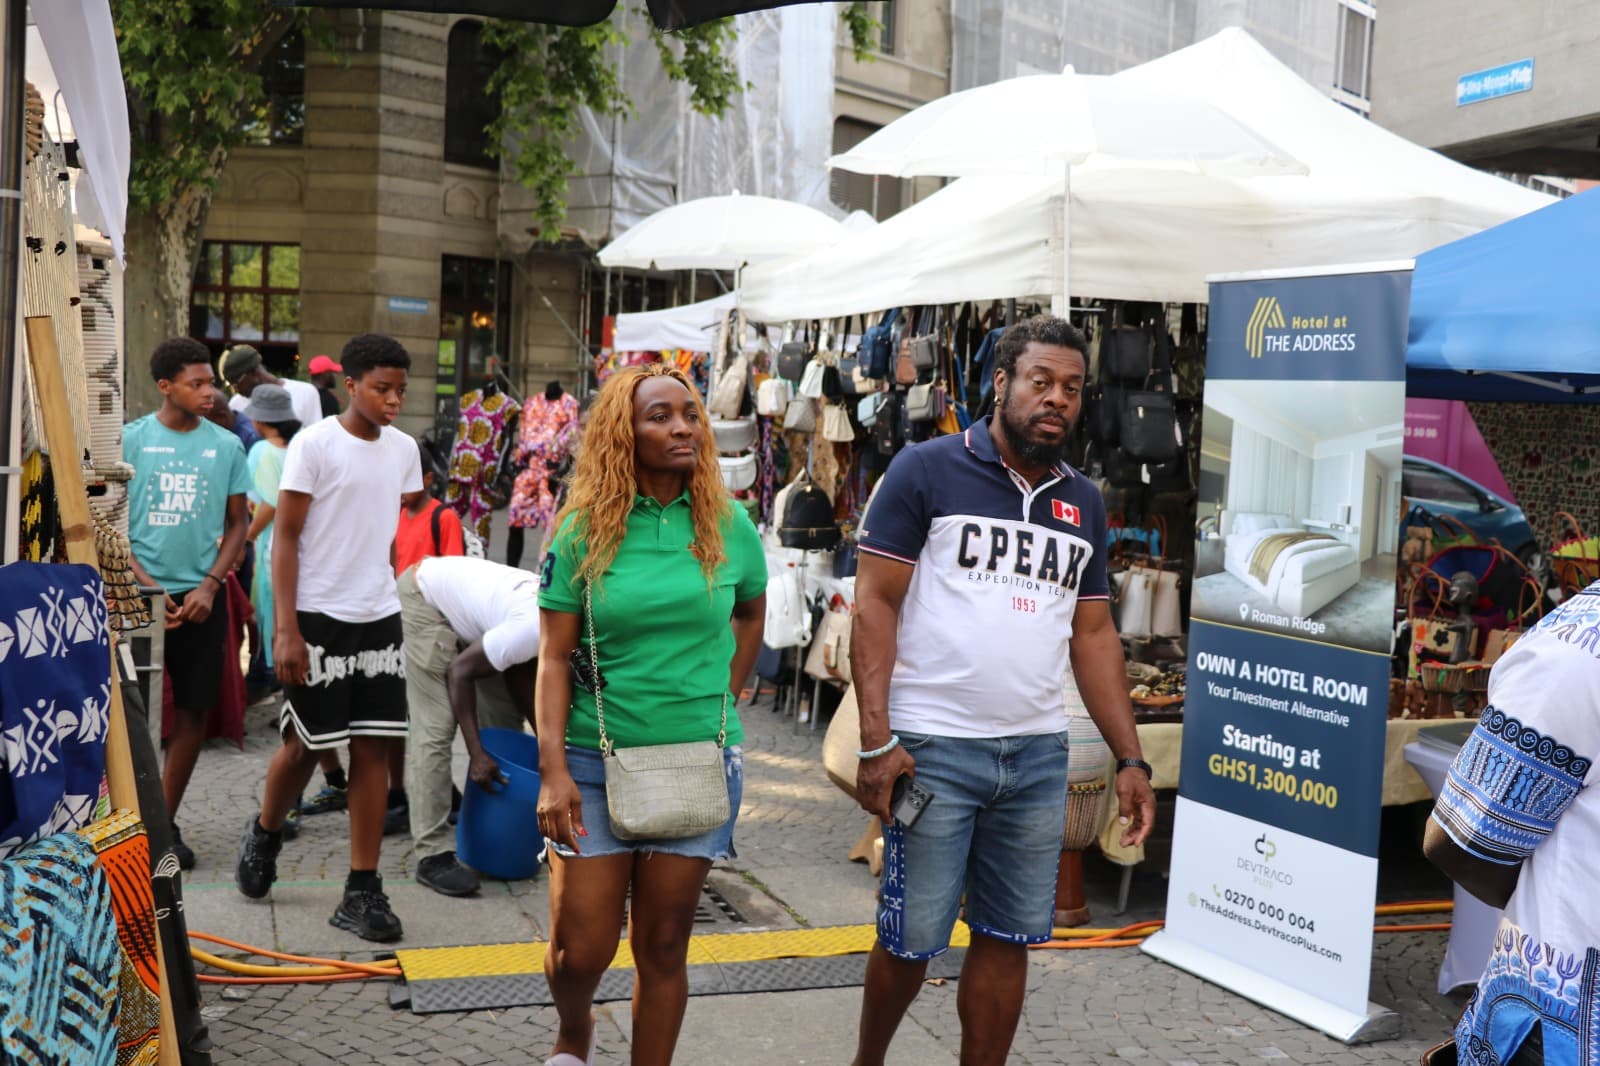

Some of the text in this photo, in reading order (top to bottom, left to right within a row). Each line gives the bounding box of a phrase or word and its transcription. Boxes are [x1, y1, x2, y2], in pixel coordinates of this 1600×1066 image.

[1292, 315, 1347, 329] Hotel at
[1265, 333, 1356, 352] THE ADDRESS
[160, 472, 198, 493] DEE
[159, 492, 197, 512] JAY
[153, 514, 177, 524] TEN
[968, 571, 1041, 591] EXPEDITION
[1012, 596, 1036, 613] 1953
[1252, 608, 1326, 635] Roman Ridge
[1196, 651, 1368, 706] OWN A HOTEL ROOM
[1207, 681, 1350, 727] Your Investment Alternative
[1222, 724, 1321, 769] Starting at
[1208, 753, 1338, 809] GHS1,300,000
[1236, 856, 1294, 886] DEVTRACO
[1224, 889, 1315, 933] 0270 000 004
[1200, 898, 1343, 963] TheAddress.DevtracoPlus.com
